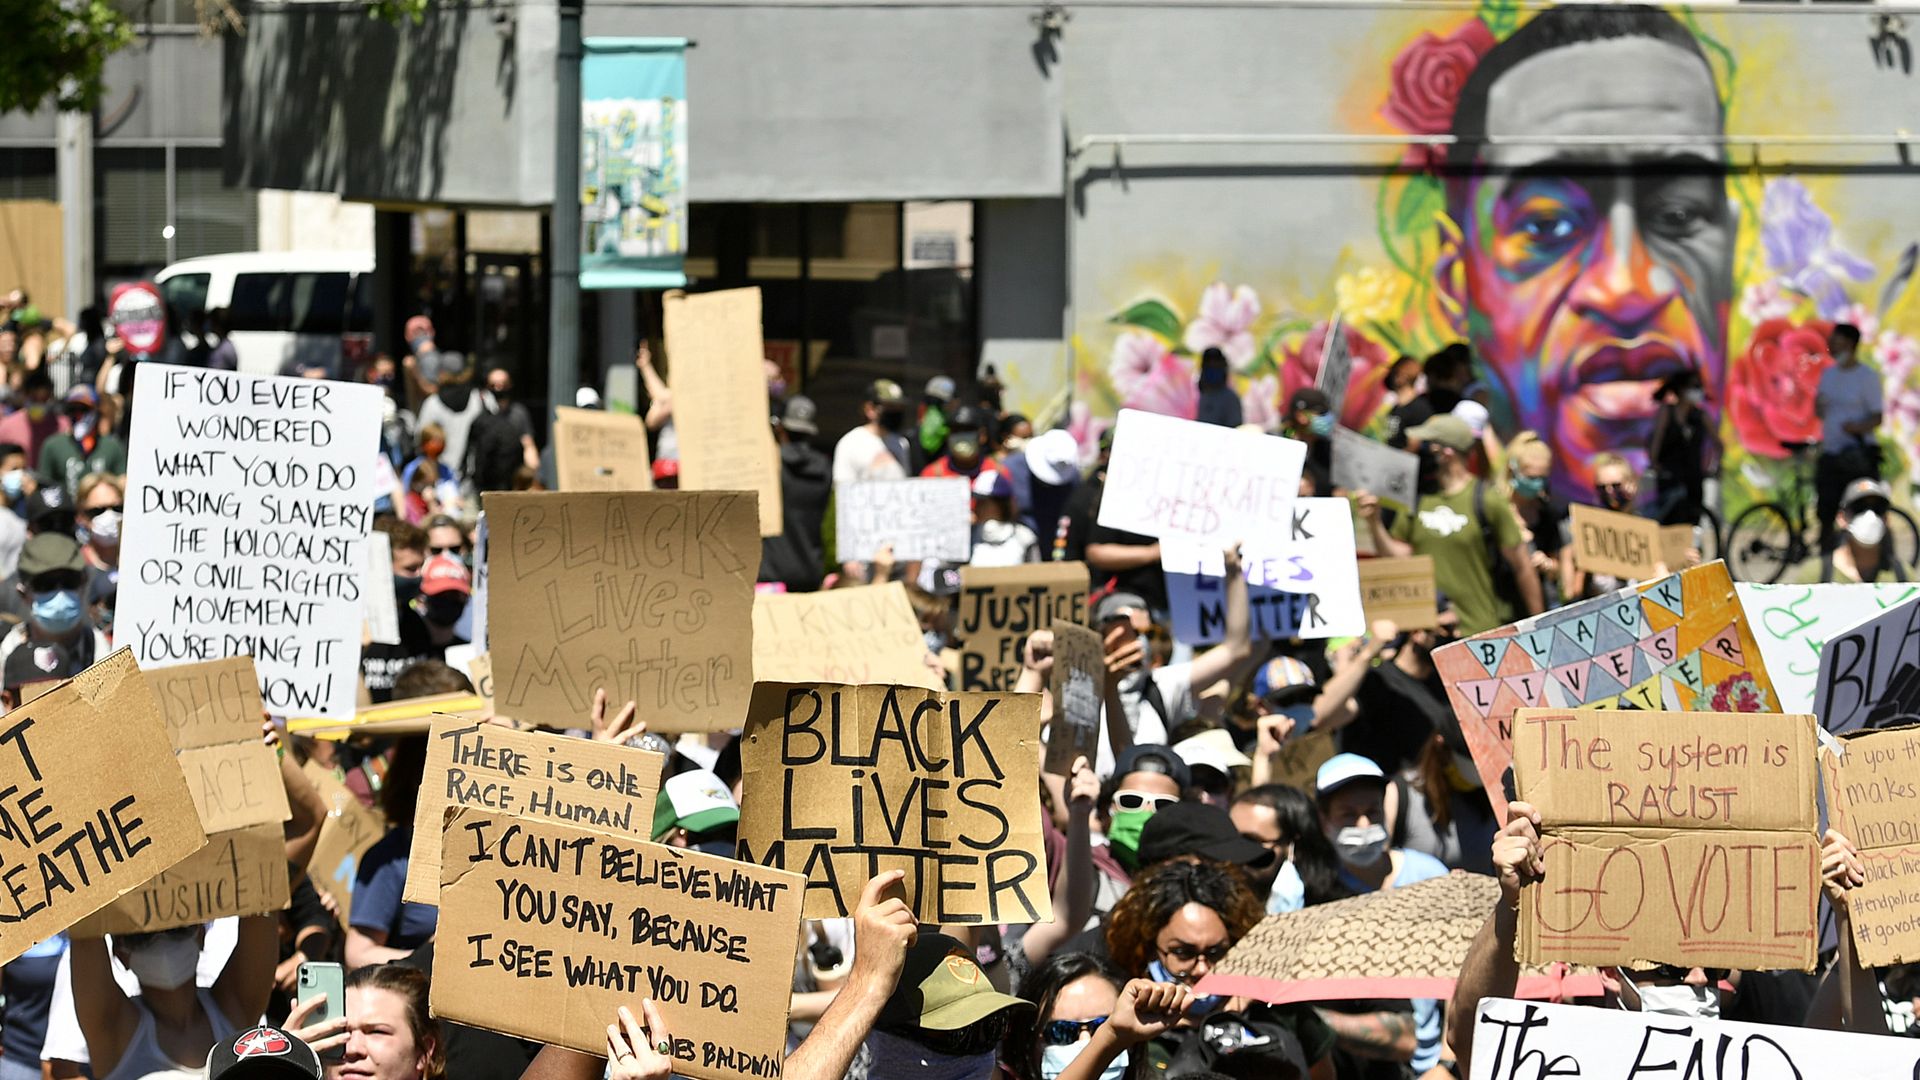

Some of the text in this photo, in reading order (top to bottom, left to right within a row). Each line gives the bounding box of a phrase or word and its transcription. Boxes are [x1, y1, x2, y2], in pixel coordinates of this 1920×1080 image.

[164, 371, 332, 414] IF YOU EVER
[177, 415, 332, 447] WONDERED
[155, 448, 226, 477] WHAT
[233, 455, 308, 488] YOU'D
[317, 462, 355, 491] DO
[143, 485, 369, 538] DURING SLAVERY,
[1139, 496, 1220, 535] SPEED
[167, 523, 208, 554] THE
[511, 494, 748, 581] BLACK
[140, 559, 360, 601] OR CIVIL RIGHTS
[1195, 556, 1314, 591] LVES
[172, 595, 324, 627] MOVEMENT
[795, 594, 912, 636] KNOW
[1199, 592, 1328, 638] MTTER
[1482, 585, 1680, 666] BLACK
[136, 620, 217, 662] YOU'RE
[224, 633, 301, 668] DOING
[315, 638, 343, 668] IT
[505, 637, 733, 714] Matter
[808, 661, 871, 684] YOU
[1475, 638, 1675, 707] LIVES
[1498, 637, 1742, 741] MTER
[157, 668, 261, 730] STICE
[781, 685, 1006, 780] BLACK
[1526, 715, 1790, 790] The system is
[440, 723, 531, 779] THERE
[586, 763, 642, 798] ONE
[1863, 747, 1896, 773] you
[199, 755, 264, 818] ACE
[1607, 781, 1738, 825] RACIST
[1846, 777, 1917, 807] makes
[1852, 813, 1920, 851] Imagi
[0, 794, 152, 922] EATHE
[464, 820, 788, 912] I CAN'T BELIEVE WHAT
[1862, 855, 1920, 883] black live
[1535, 839, 1815, 939] GO VOTE!
[496, 878, 751, 963] YOU SAY, BECAUSE
[467, 933, 739, 1013] I SEE WHAT YOU DO.
[702, 1041, 781, 1079] BALDWIN
[1481, 1004, 1804, 1080] The END
